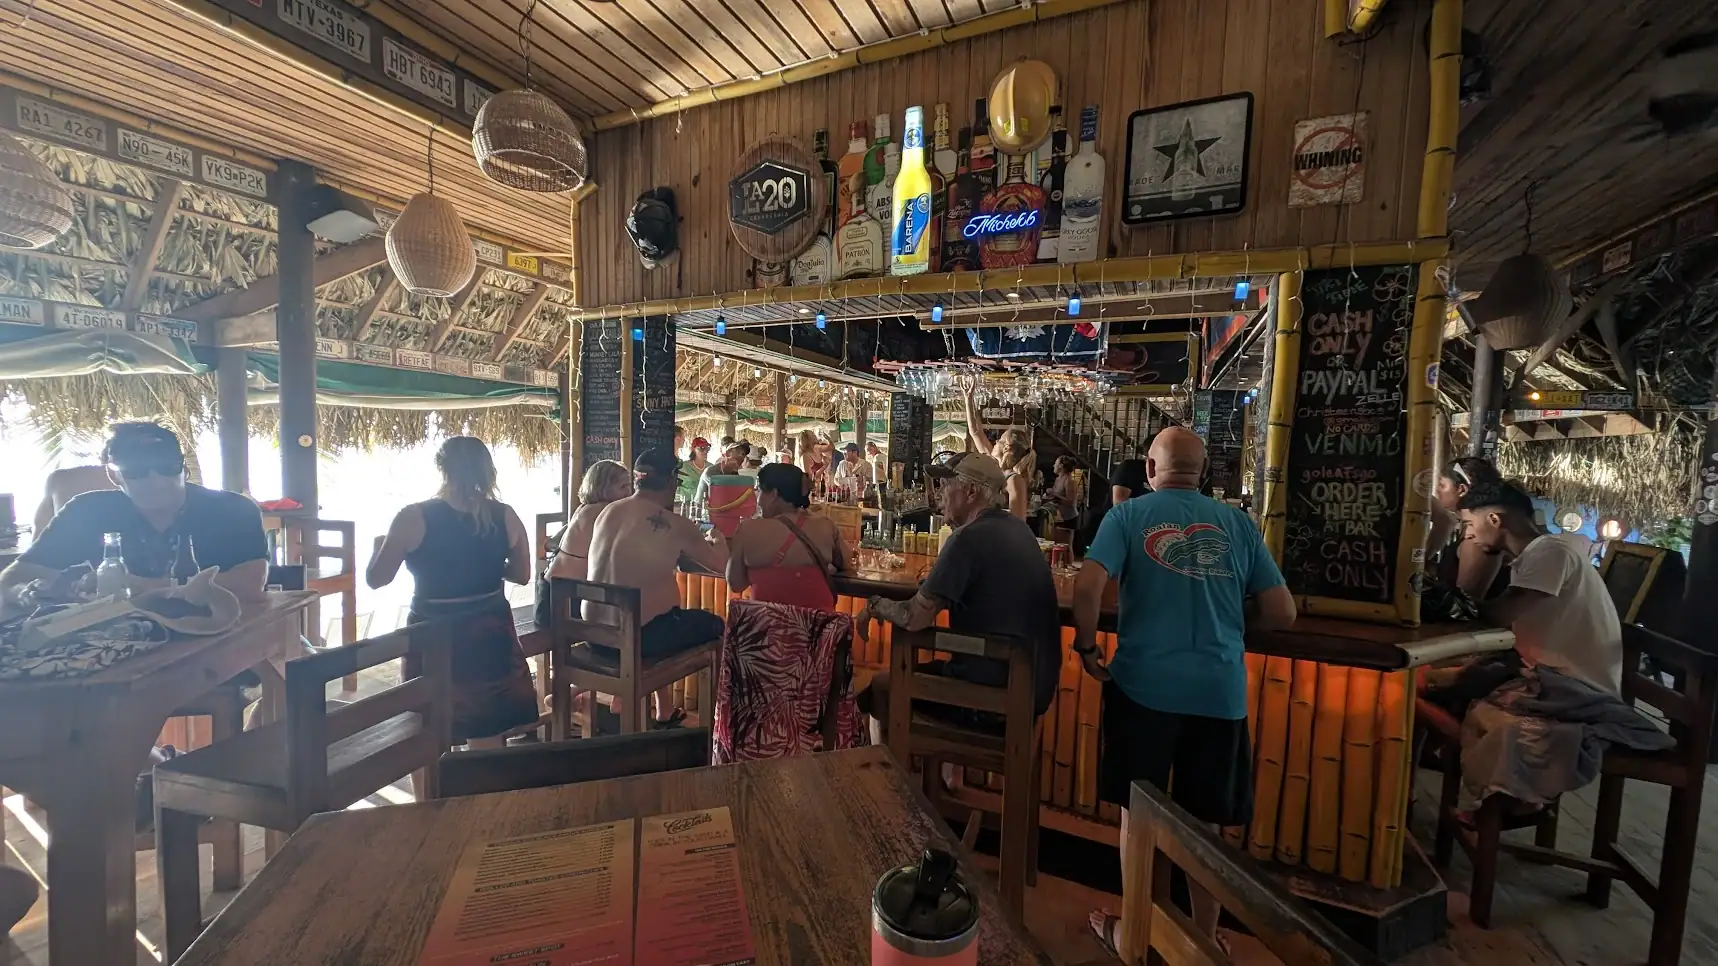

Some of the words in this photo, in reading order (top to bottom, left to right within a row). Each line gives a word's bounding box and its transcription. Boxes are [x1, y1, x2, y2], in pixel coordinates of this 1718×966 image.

[390, 50, 416, 81] HBT
[420, 63, 453, 97] 6943
[64, 119, 103, 143] 4267
[1294, 146, 1363, 171] WHINING
[762, 176, 797, 212] 20
[904, 202, 914, 254] BARENA
[1308, 309, 1374, 336] CASH
[1310, 333, 1373, 372] ONLY
[1301, 369, 1388, 406] PAYPAL
[1355, 392, 1401, 406] ZELLE
[1305, 432, 1401, 457] VENMO
[1311, 481, 1388, 509] ORDER
[1324, 501, 1384, 522] HERE
[1323, 520, 1345, 533] AT
[1345, 520, 1382, 539] BAR
[1320, 537, 1388, 565] CASH
[1325, 561, 1389, 600] ONLY
[663, 812, 713, 835] Cocktails
